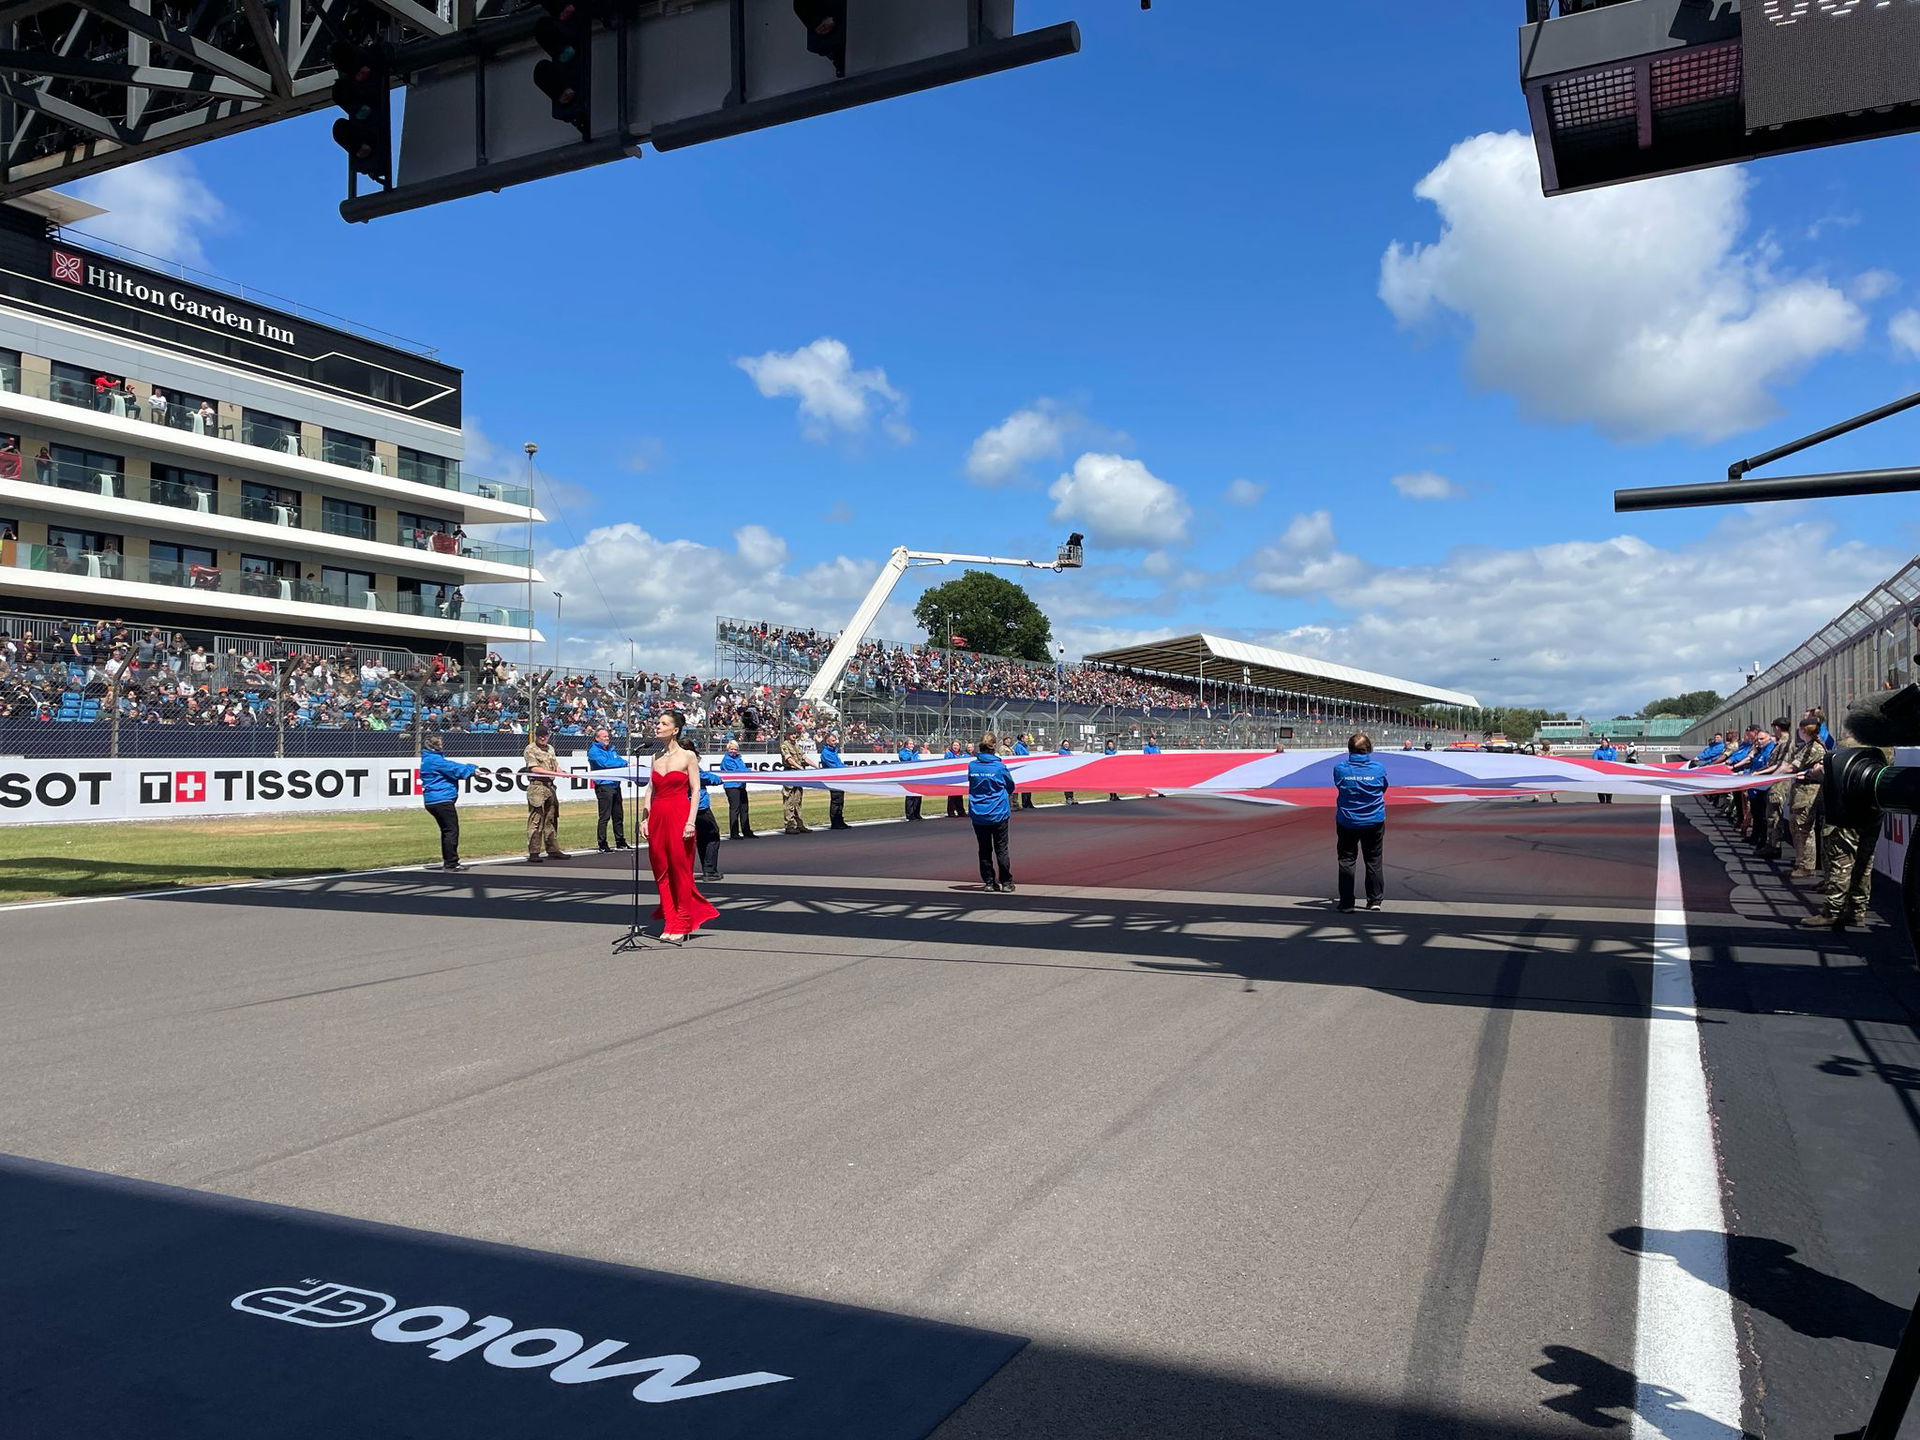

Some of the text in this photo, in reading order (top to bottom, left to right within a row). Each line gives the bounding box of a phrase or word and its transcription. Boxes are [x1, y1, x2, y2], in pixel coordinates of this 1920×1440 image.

[88, 265, 296, 346] Hilton Garden Inn
[214, 769, 369, 801] TISSOT
